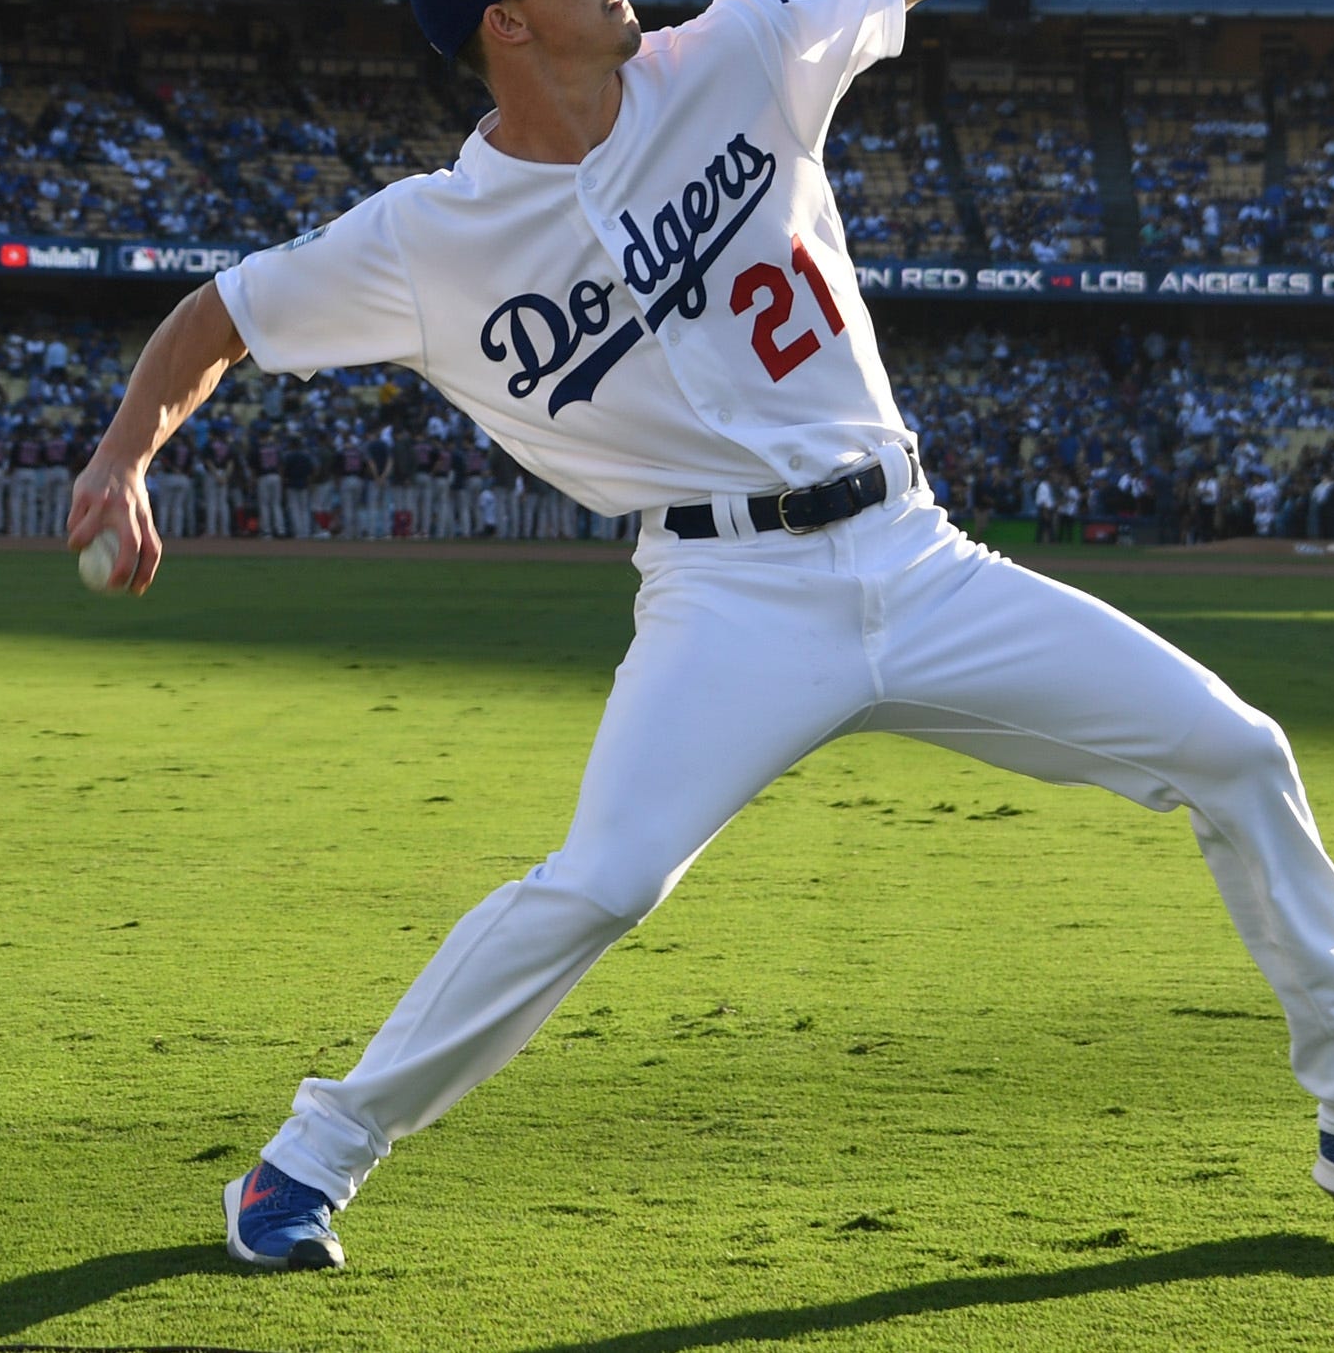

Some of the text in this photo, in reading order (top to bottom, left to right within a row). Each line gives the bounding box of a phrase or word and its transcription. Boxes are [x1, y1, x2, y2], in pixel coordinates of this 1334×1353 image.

[480, 133, 777, 420] Dodgers
[729, 233, 845, 383] 21
[900, 267, 967, 291] RED
[976, 268, 1044, 292] SOX
[1080, 270, 1148, 293] LOS
[1157, 271, 1311, 295] ANGELES
